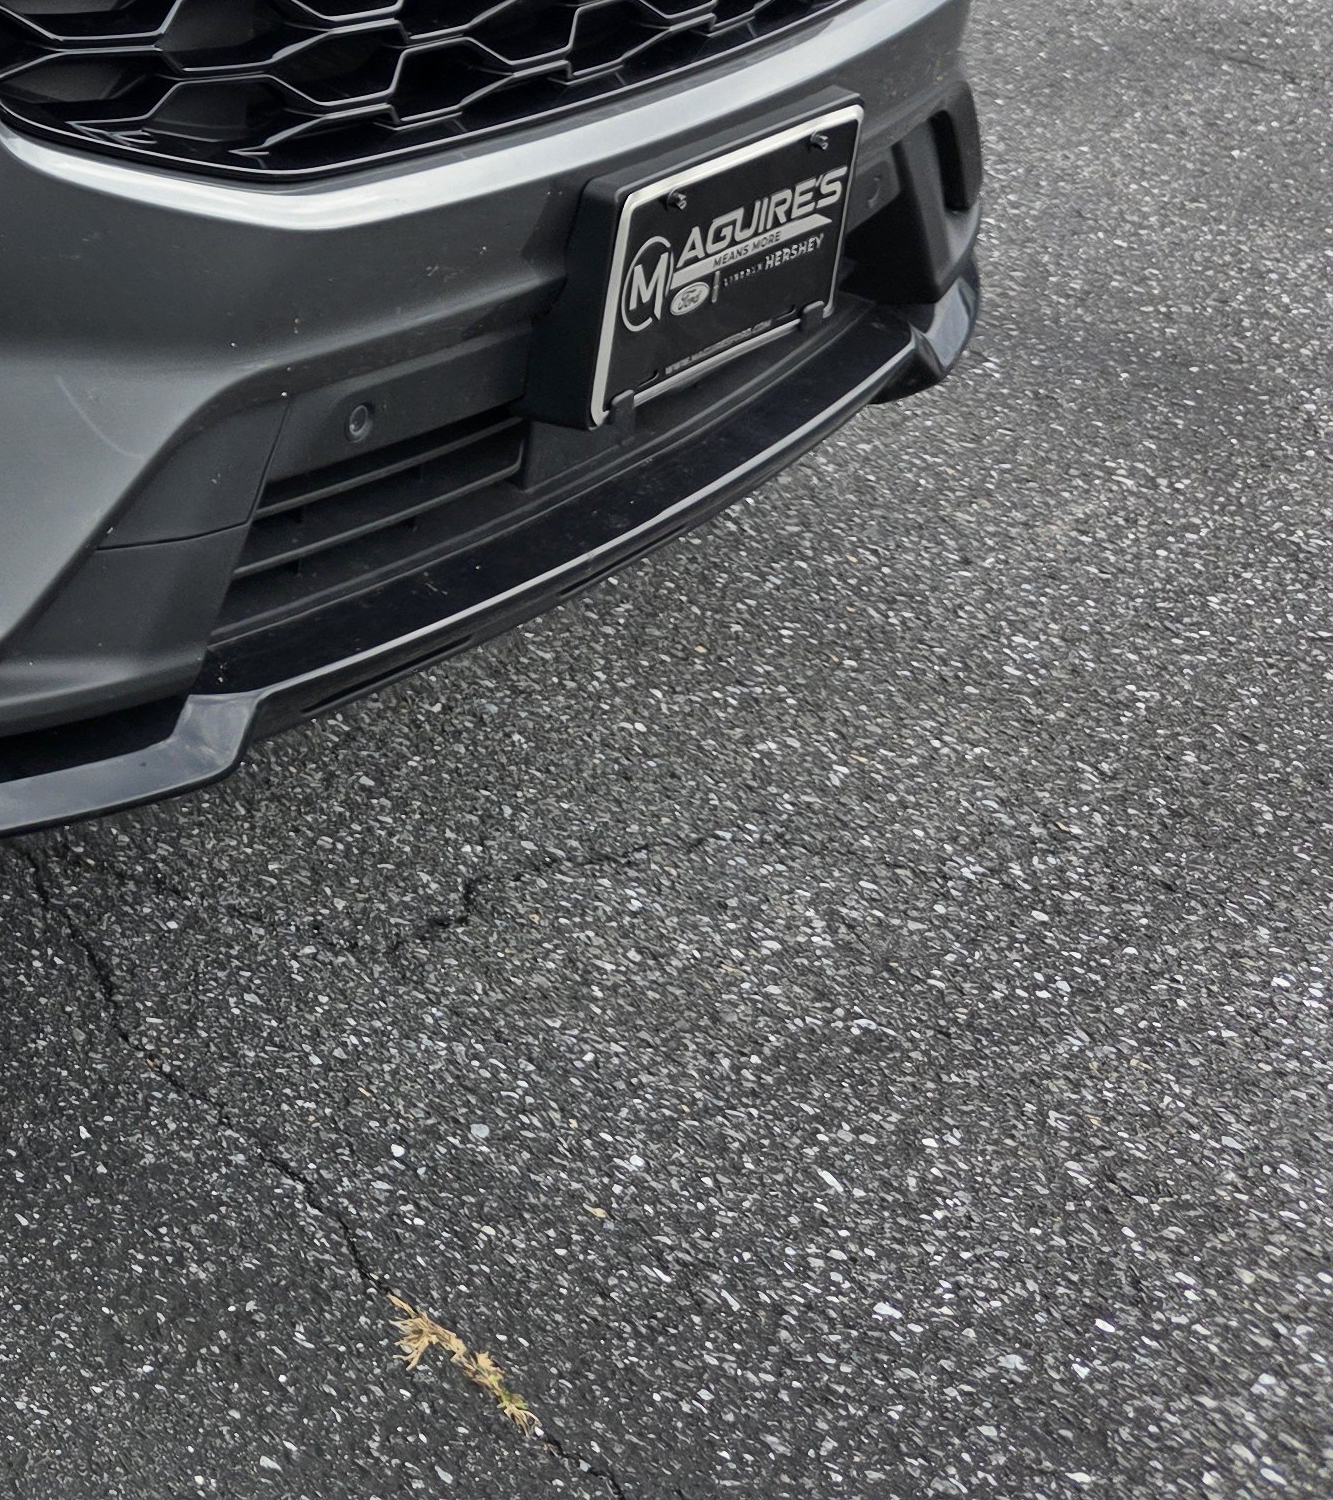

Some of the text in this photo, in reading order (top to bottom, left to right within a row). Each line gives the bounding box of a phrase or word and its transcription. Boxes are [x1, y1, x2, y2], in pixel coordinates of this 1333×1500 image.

[712, 231, 781, 269] MEANS MORE
[764, 232, 825, 271] HERSHEY
